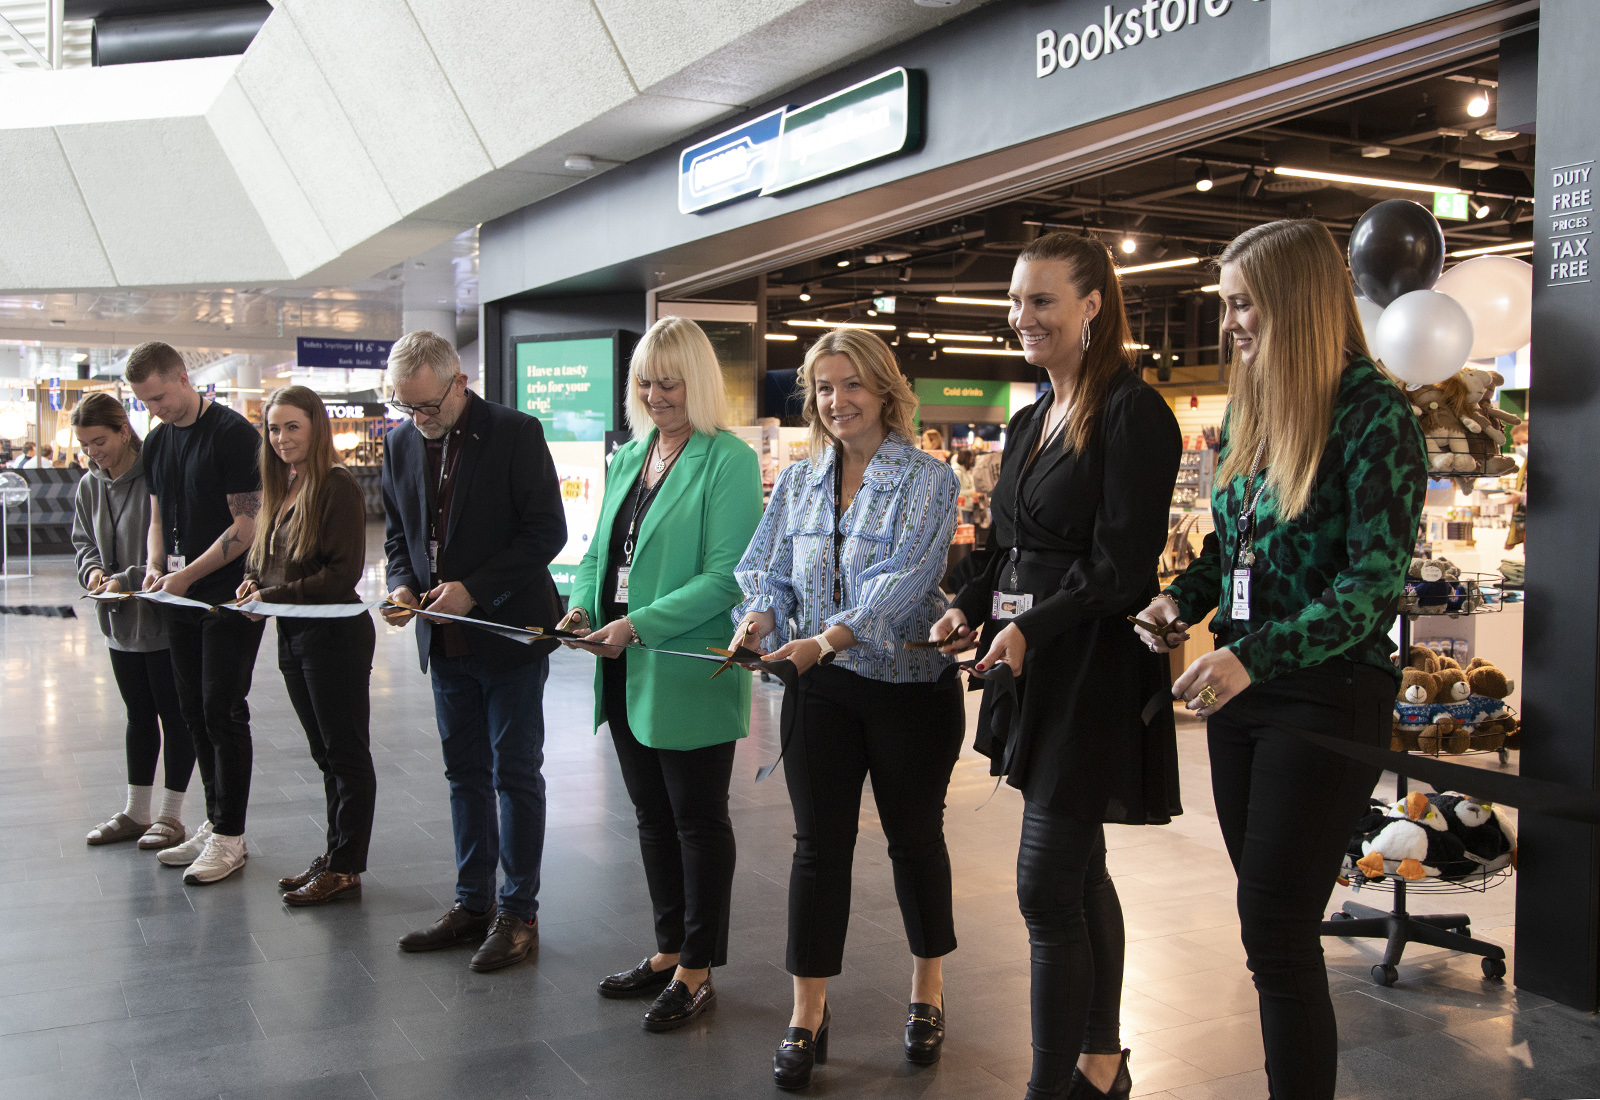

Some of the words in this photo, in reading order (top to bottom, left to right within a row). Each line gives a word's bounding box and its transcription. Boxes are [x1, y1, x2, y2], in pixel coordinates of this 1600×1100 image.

[1552, 167, 1592, 188] DUTY
[1552, 189, 1591, 211] FREE
[1552, 216, 1588, 232] PRICES
[1551, 238, 1589, 260] TAX
[1550, 260, 1588, 280] FREE
[303, 341, 322, 349] Toilets
[526, 366, 552, 377] Have
[554, 367, 560, 376] a
[562, 364, 588, 378] tasty
[526, 381, 547, 394] trio
[547, 380, 565, 393] for
[564, 382, 591, 395] your
[943, 387, 961, 396] Cold
[962, 388, 983, 396] drinks
[325, 405, 365, 418] TORE
[526, 397, 551, 413] trip!
